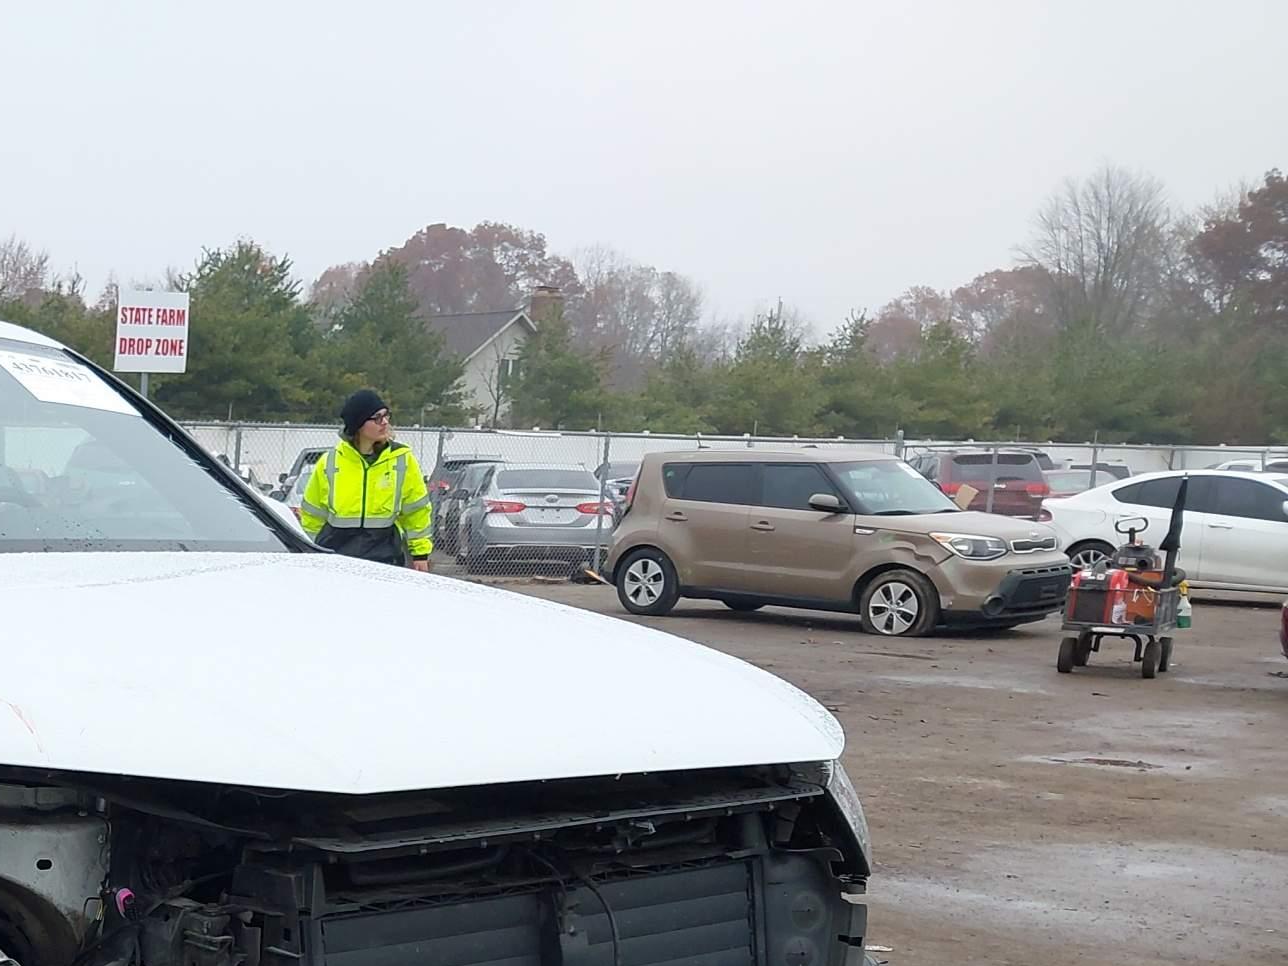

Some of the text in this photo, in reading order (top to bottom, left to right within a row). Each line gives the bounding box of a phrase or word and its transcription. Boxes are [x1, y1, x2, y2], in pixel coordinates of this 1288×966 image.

[120, 306, 186, 327] STATE FARM
[118, 337, 185, 357] DROP ZONE
